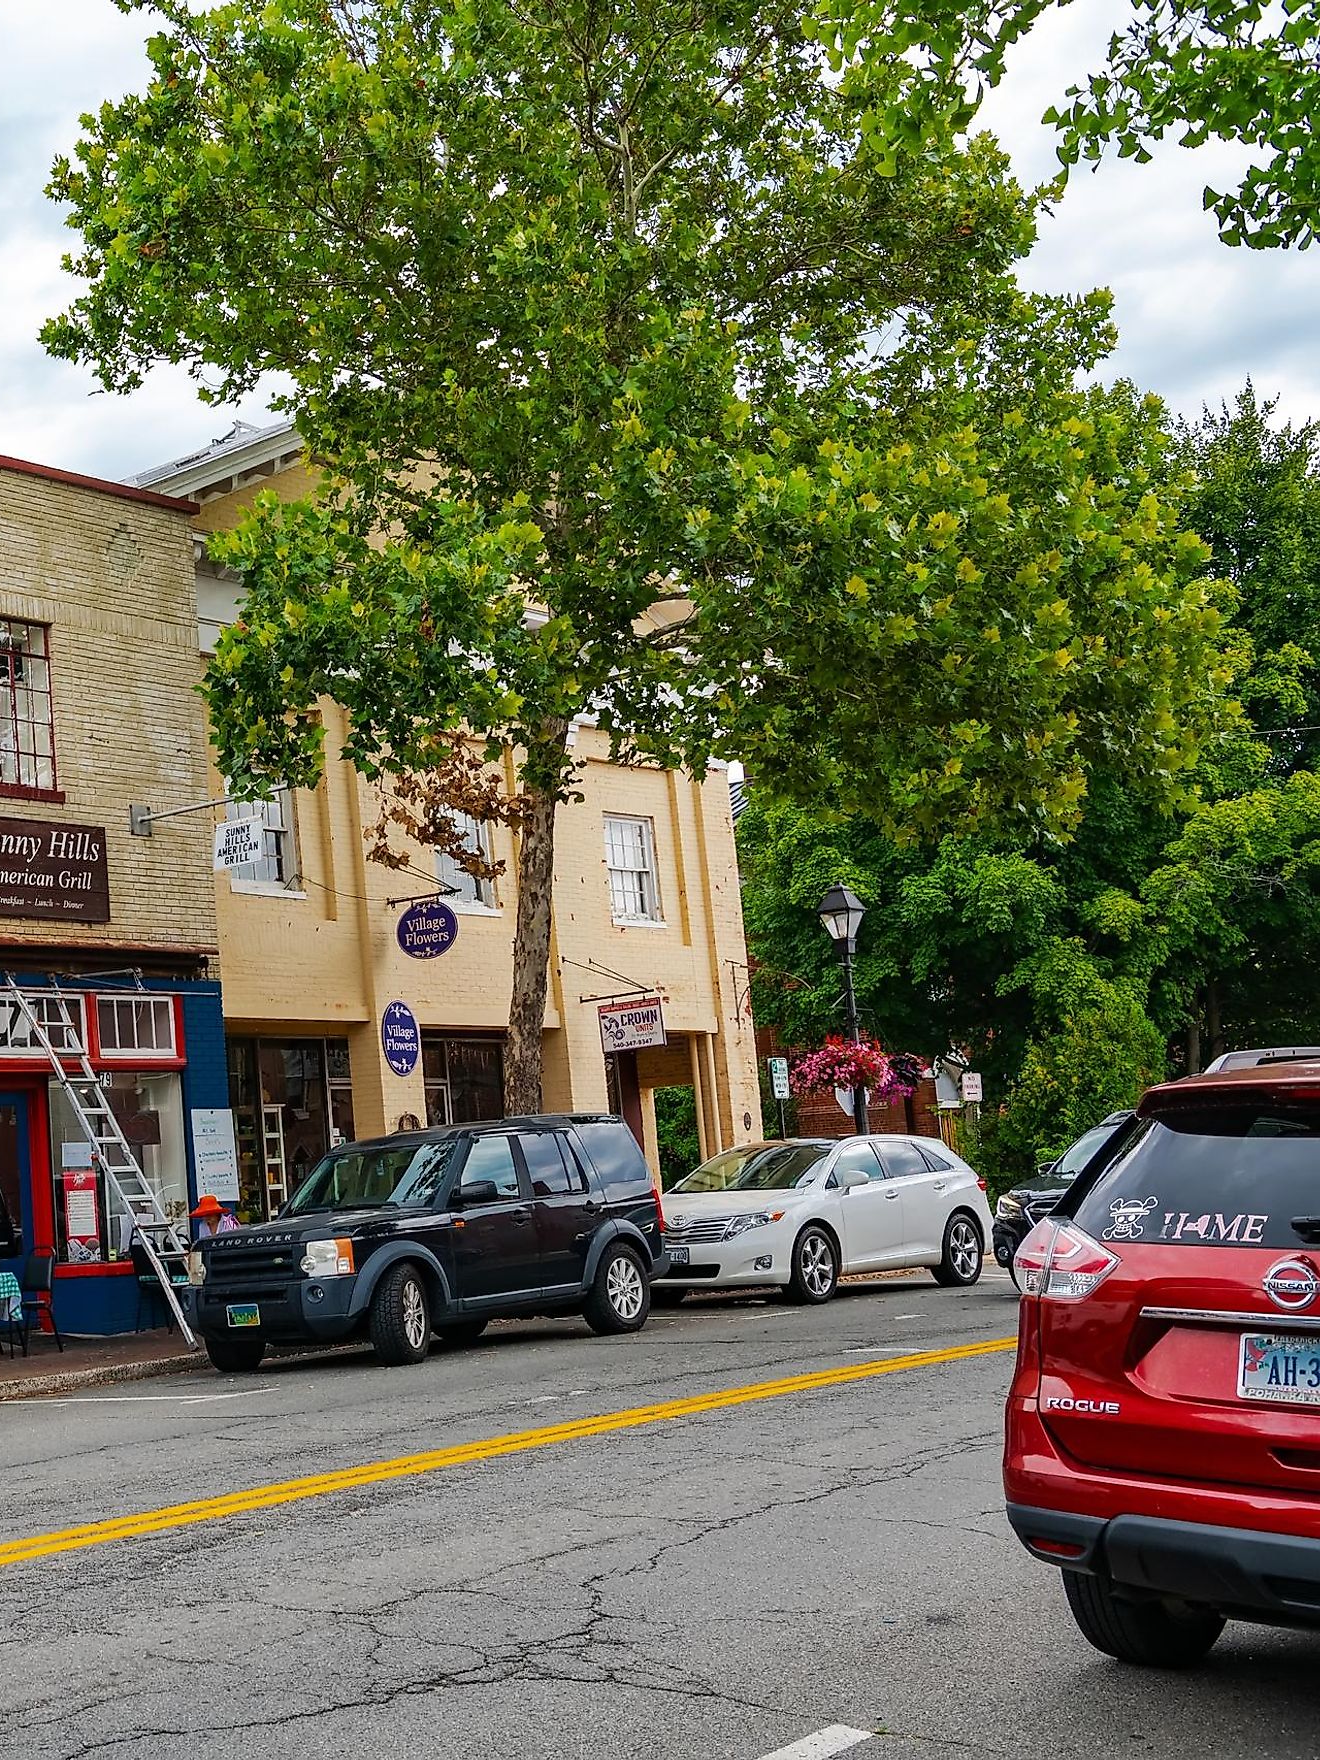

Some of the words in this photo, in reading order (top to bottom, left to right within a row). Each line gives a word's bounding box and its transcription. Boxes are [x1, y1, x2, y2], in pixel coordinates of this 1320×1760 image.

[226, 823, 251, 838] SUNNY
[47, 830, 100, 862] Hills
[224, 833, 251, 847] HILLS
[217, 840, 259, 858] AMERICAN
[224, 853, 250, 865] GRILL
[58, 870, 92, 890] Grill
[34, 898, 54, 908] Lunch
[63, 900, 84, 909] Dinner
[406, 916, 446, 934] Village
[405, 930, 450, 947] Flowers
[620, 1009, 658, 1027] CROWN
[386, 1024, 415, 1040] Village
[635, 1023, 654, 1033] UNITS
[386, 1038, 418, 1052] Flowers
[99, 1073, 112, 1087] 79
[212, 1239, 241, 1248] LAND
[247, 1234, 293, 1245] ROVER
[1267, 1281, 1315, 1291] NISSAN
[1046, 1397, 1121, 1414] ROGUE
